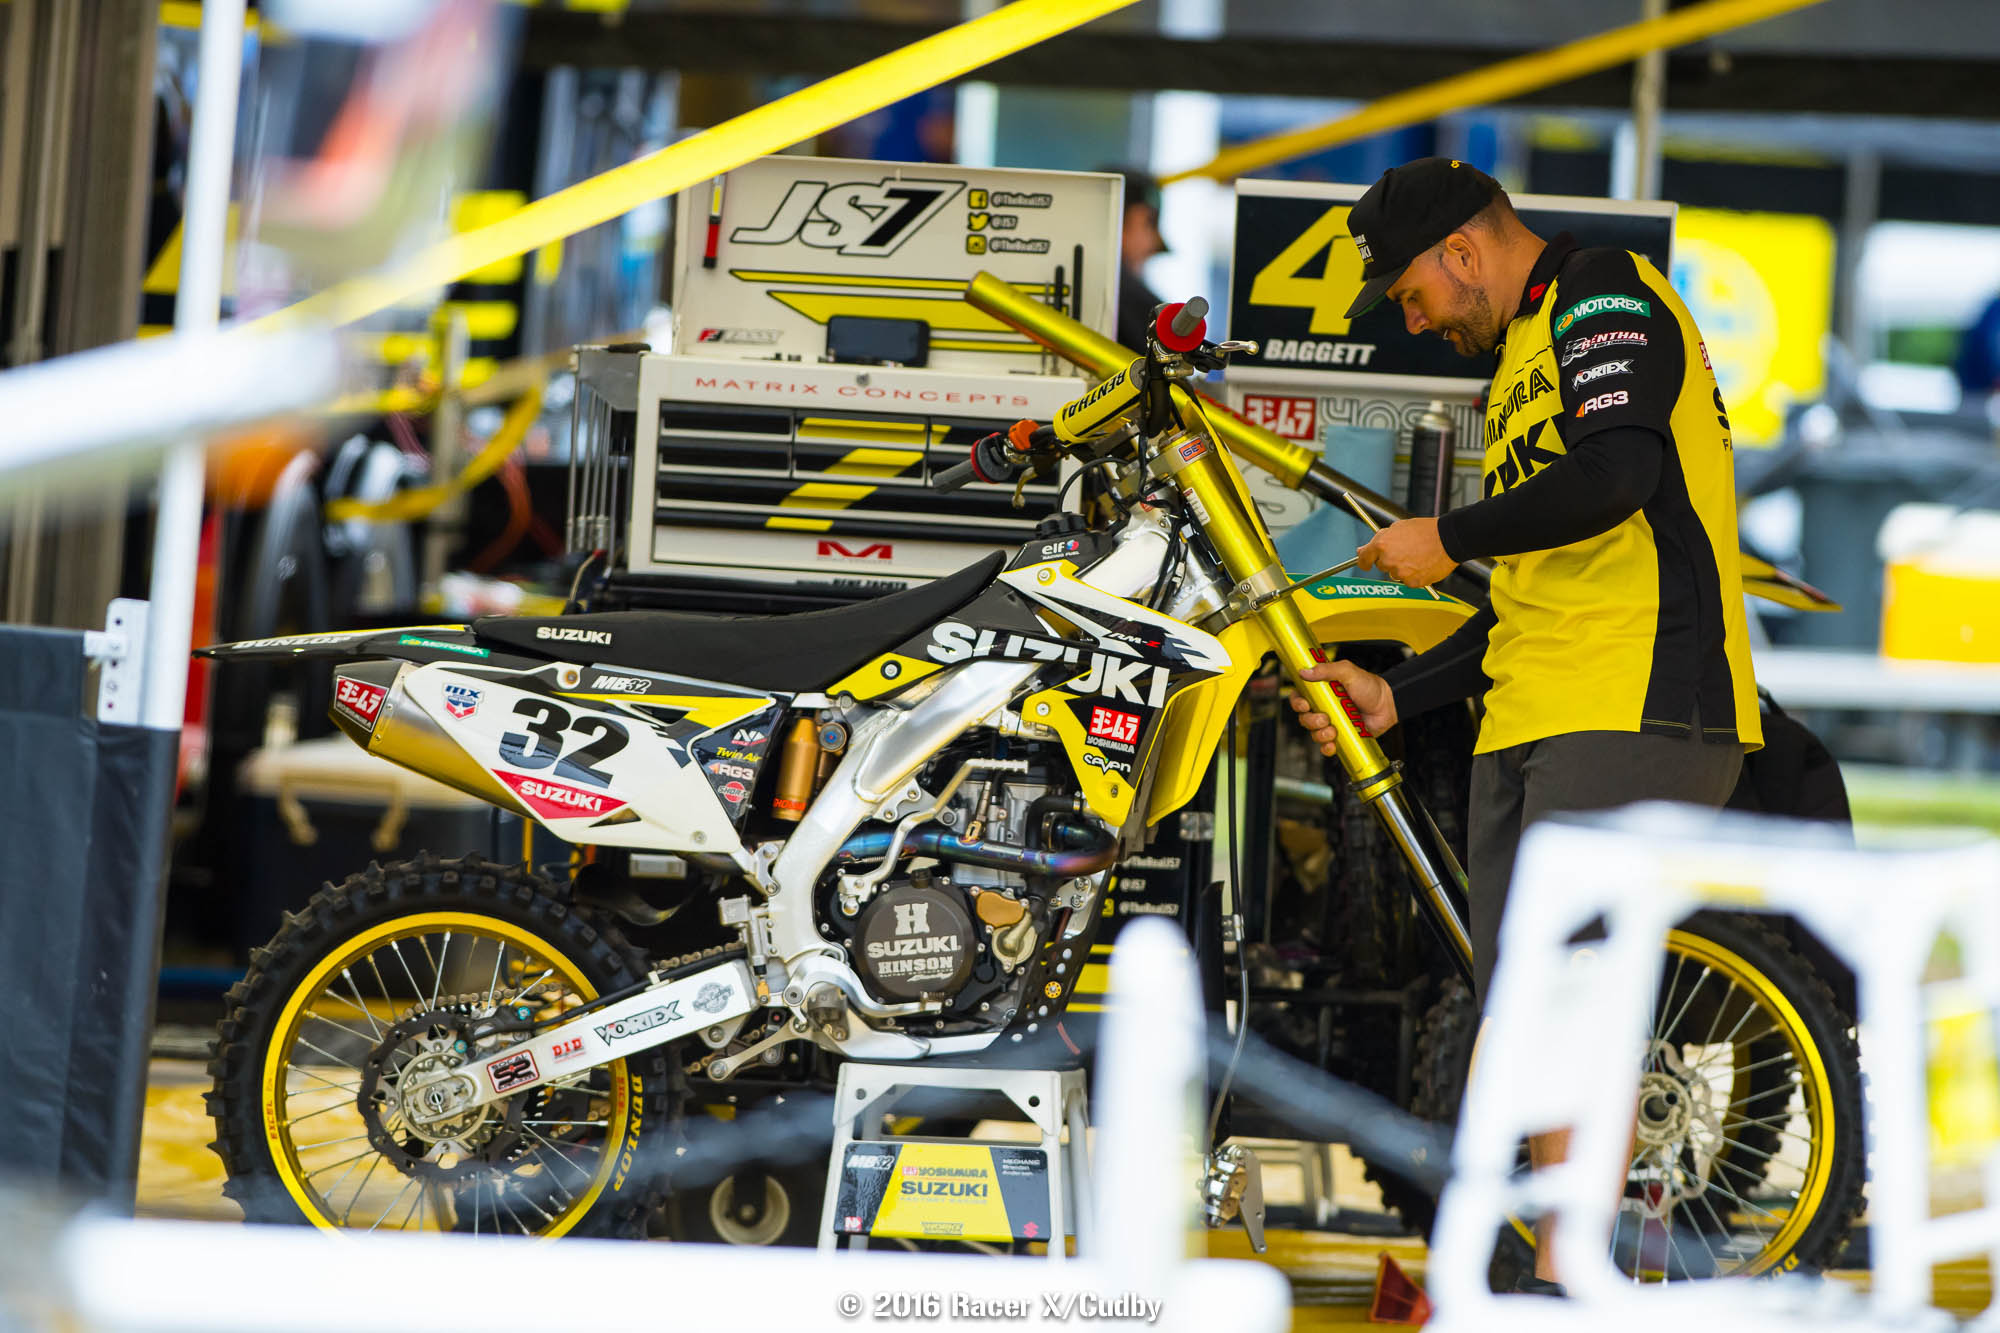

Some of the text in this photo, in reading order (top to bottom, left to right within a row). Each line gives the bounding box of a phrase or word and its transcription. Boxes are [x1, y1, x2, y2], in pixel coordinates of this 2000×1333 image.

[729, 178, 967, 257] JS7
[1249, 206, 1368, 336] 4
[1574, 297, 1646, 318] MOTOREX
[1264, 338, 1376, 366] BAGGETT
[1580, 331, 1648, 351] RENTHAL
[1572, 360, 1634, 391] VORTEX
[696, 377, 1029, 406] MATRIX CONCEPTS
[1583, 390, 1629, 415] RG3
[1042, 541, 1066, 555] elf
[1335, 584, 1403, 596] MOTOREX
[231, 636, 351, 650] DUNLOP
[536, 626, 612, 645] SUZUKI
[1108, 632, 1162, 648] RM-Z
[421, 640, 485, 655] MOTOREX
[591, 675, 652, 694] MB32
[338, 681, 382, 714] ヨシムラ
[1091, 709, 1139, 741] ヨシムラ
[499, 697, 630, 789] 32
[1086, 736, 1135, 754] YOSHIMURA
[716, 746, 763, 763] Twin Air
[719, 763, 754, 781] RG3
[520, 780, 602, 812] SUZUKI
[894, 903, 930, 936] H
[867, 935, 958, 959] SUZUKI
[878, 956, 954, 974] HINSON
[594, 1000, 684, 1046] VORTEX
[266, 1100, 278, 1140] EXCEL
[613, 1072, 643, 1191] DUNLOP
[919, 1167, 988, 1178] YOSHIMURA
[901, 1181, 988, 1197] SUZUKI
